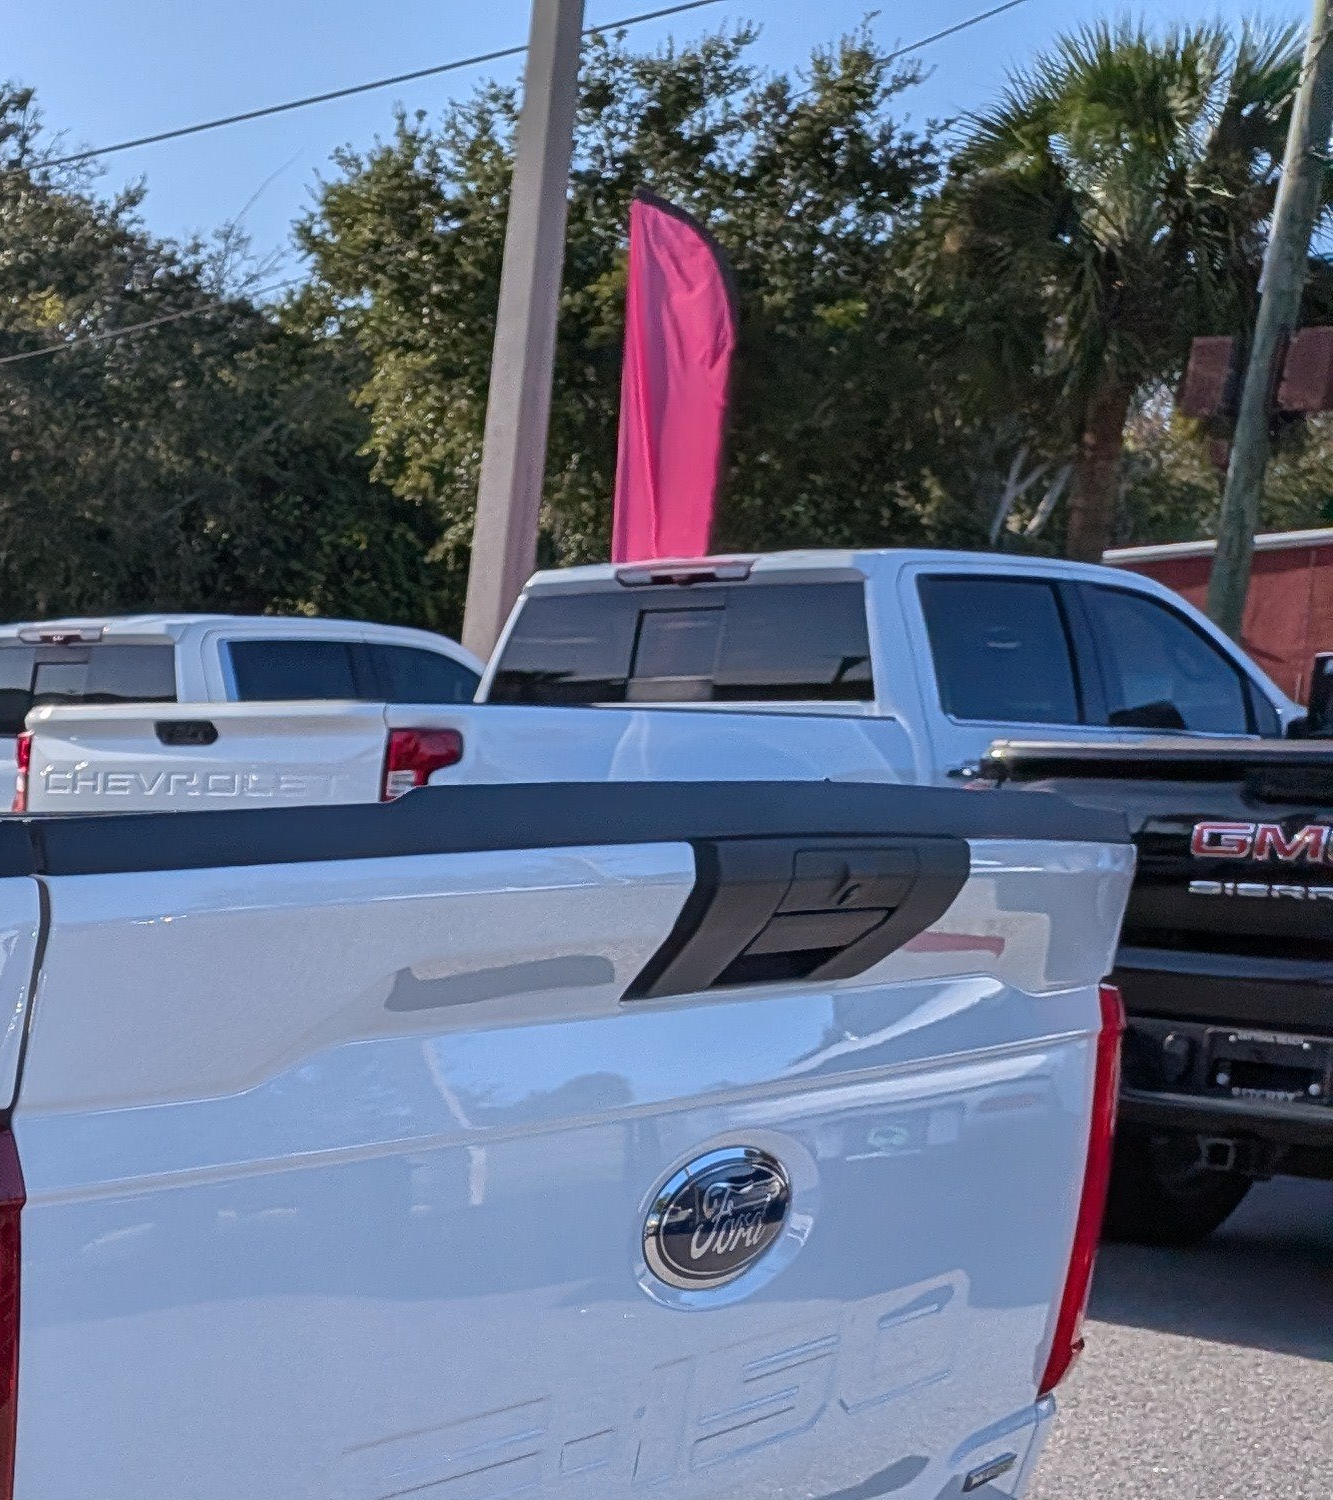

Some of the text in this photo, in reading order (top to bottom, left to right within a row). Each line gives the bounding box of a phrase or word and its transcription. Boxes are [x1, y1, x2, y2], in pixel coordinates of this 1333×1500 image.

[43, 769, 347, 798] CHEVROLET
[1190, 821, 1333, 863] GM
[690, 1177, 780, 1260] Ford
